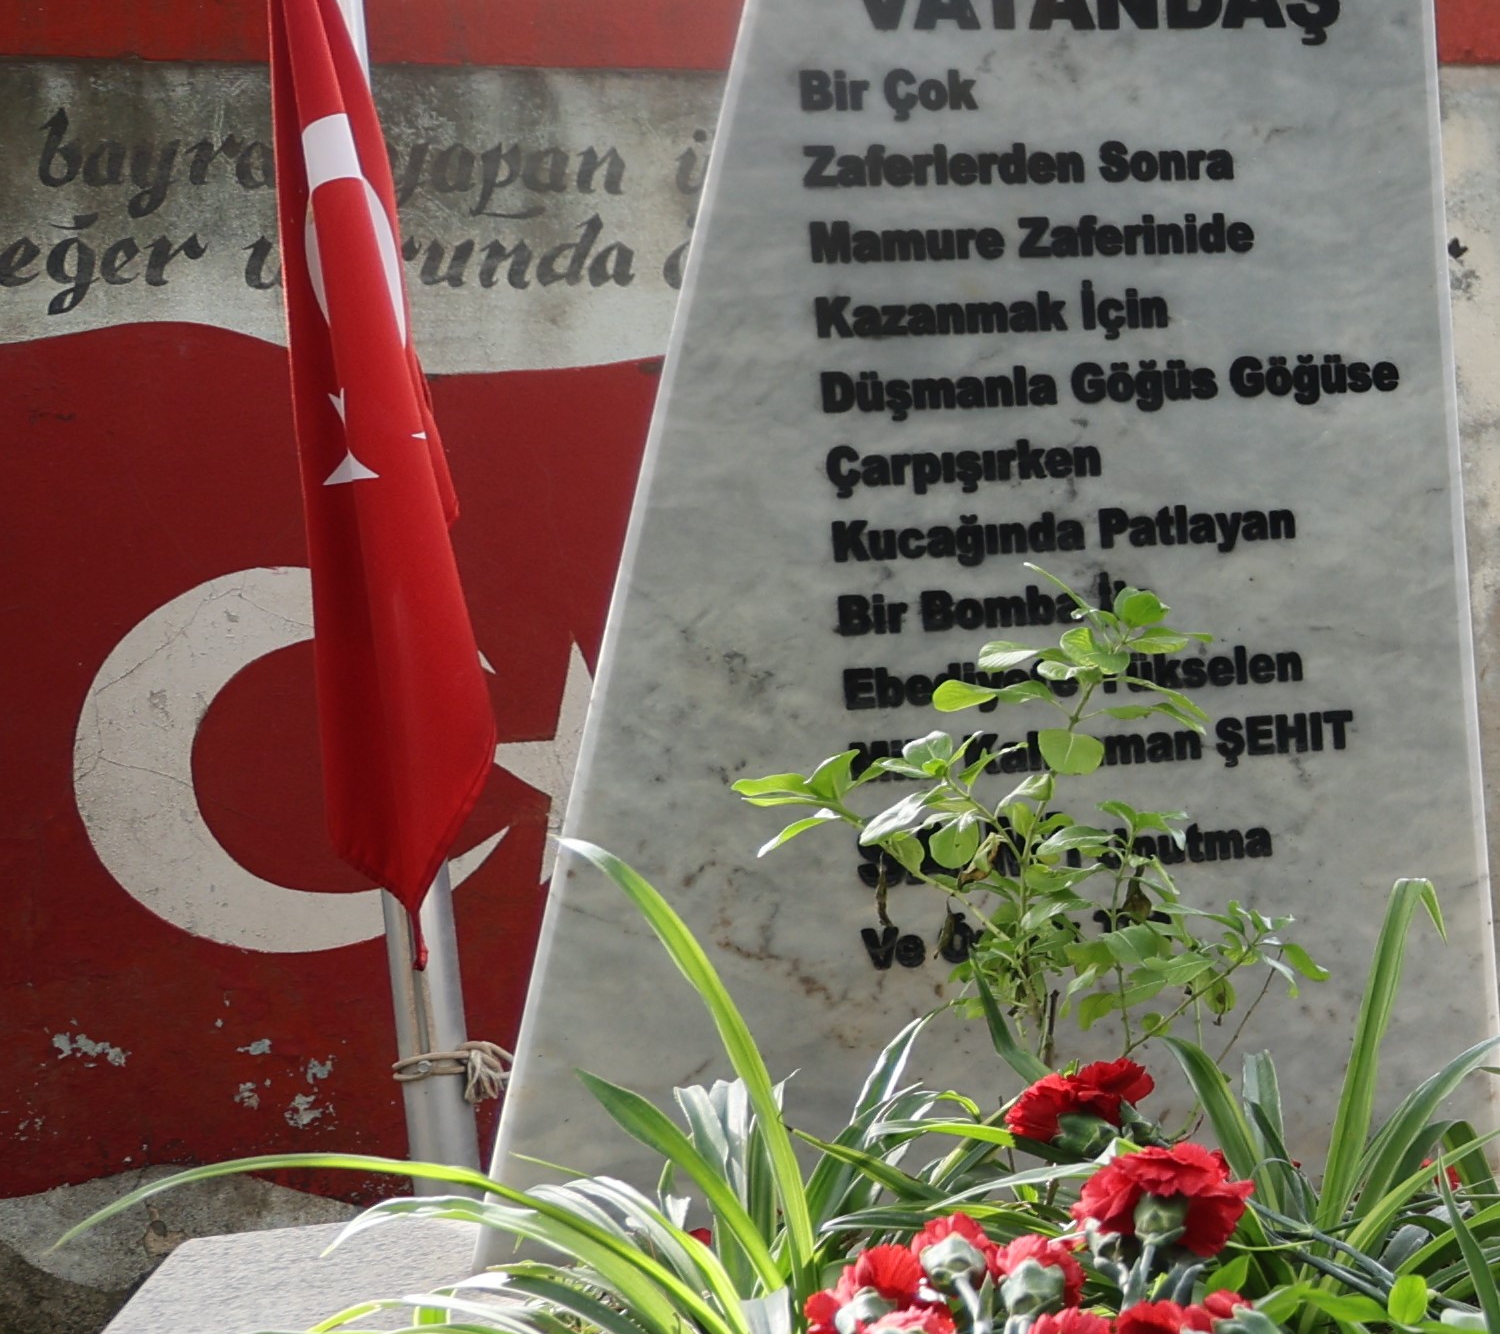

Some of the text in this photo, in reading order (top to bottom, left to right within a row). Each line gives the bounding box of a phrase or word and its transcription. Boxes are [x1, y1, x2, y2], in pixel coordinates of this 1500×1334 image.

[799, 68, 979, 122] Bir Çok
[39, 106, 277, 220] bayra
[802, 139, 1236, 189] Zaferlerden Sonra
[0, 212, 209, 315] eğer
[807, 212, 1256, 265] Mamure Zaferinide
[814, 279, 1171, 341] Kazanmak İçin
[819, 353, 1401, 423] Düşmanla Göğüs Göğüse
[825, 438, 1103, 499] Çarpışırken
[830, 503, 1297, 567] Kucağında Patlayan
[837, 593, 909, 637] Bir
[918, 584, 1086, 633] Bomba
[1215, 709, 1354, 768] ŞEHIT
[860, 926, 927, 971] Ve
